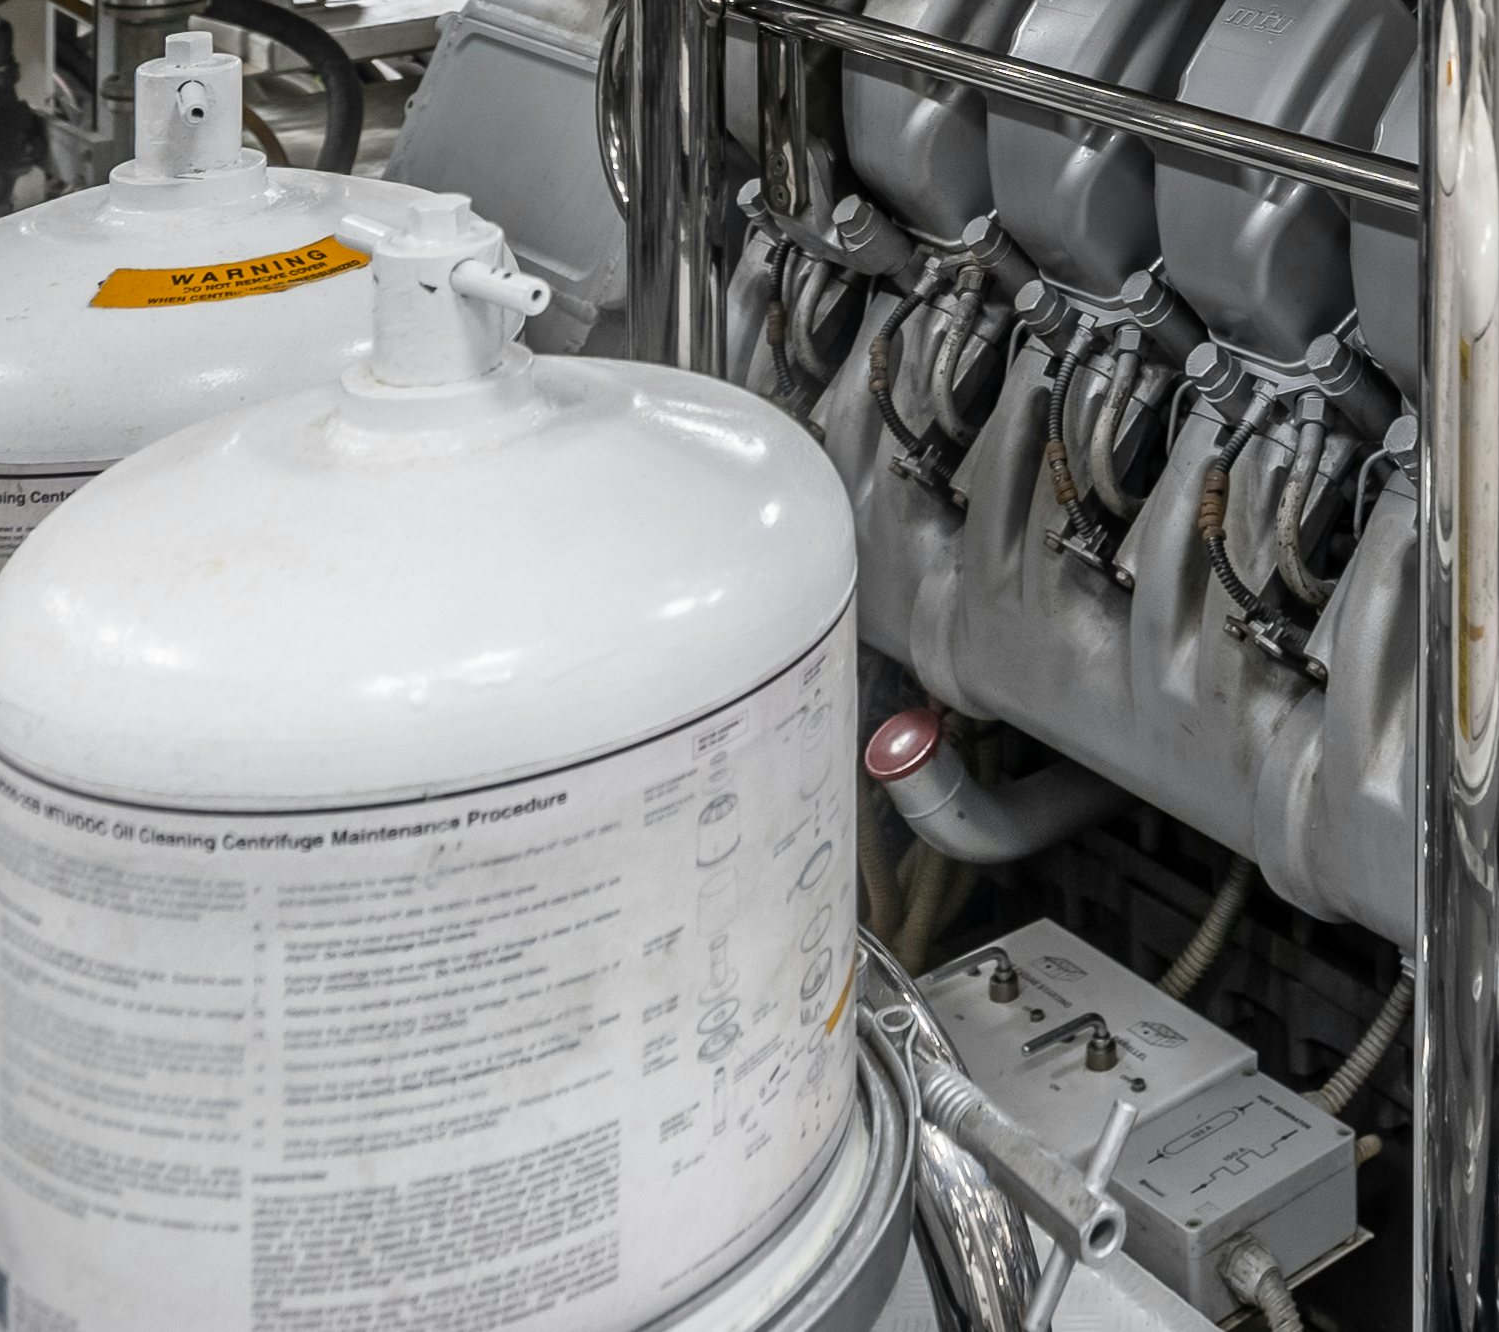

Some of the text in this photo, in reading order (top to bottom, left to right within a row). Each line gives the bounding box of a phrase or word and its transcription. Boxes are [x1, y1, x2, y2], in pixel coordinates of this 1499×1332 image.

[1223, 6, 1296, 36] mtu
[170, 248, 328, 287] WARNING
[182, 260, 328, 294] DO NOT REMOVE COVER
[147, 294, 187, 305] WHEN
[43, 805, 108, 837] MTU/DDC
[111, 823, 134, 841] Oil
[138, 827, 217, 853] Cleaning
[221, 832, 324, 853] Centrifuge
[330, 816, 461, 846] Maintenance
[466, 791, 569, 828] Procedure
